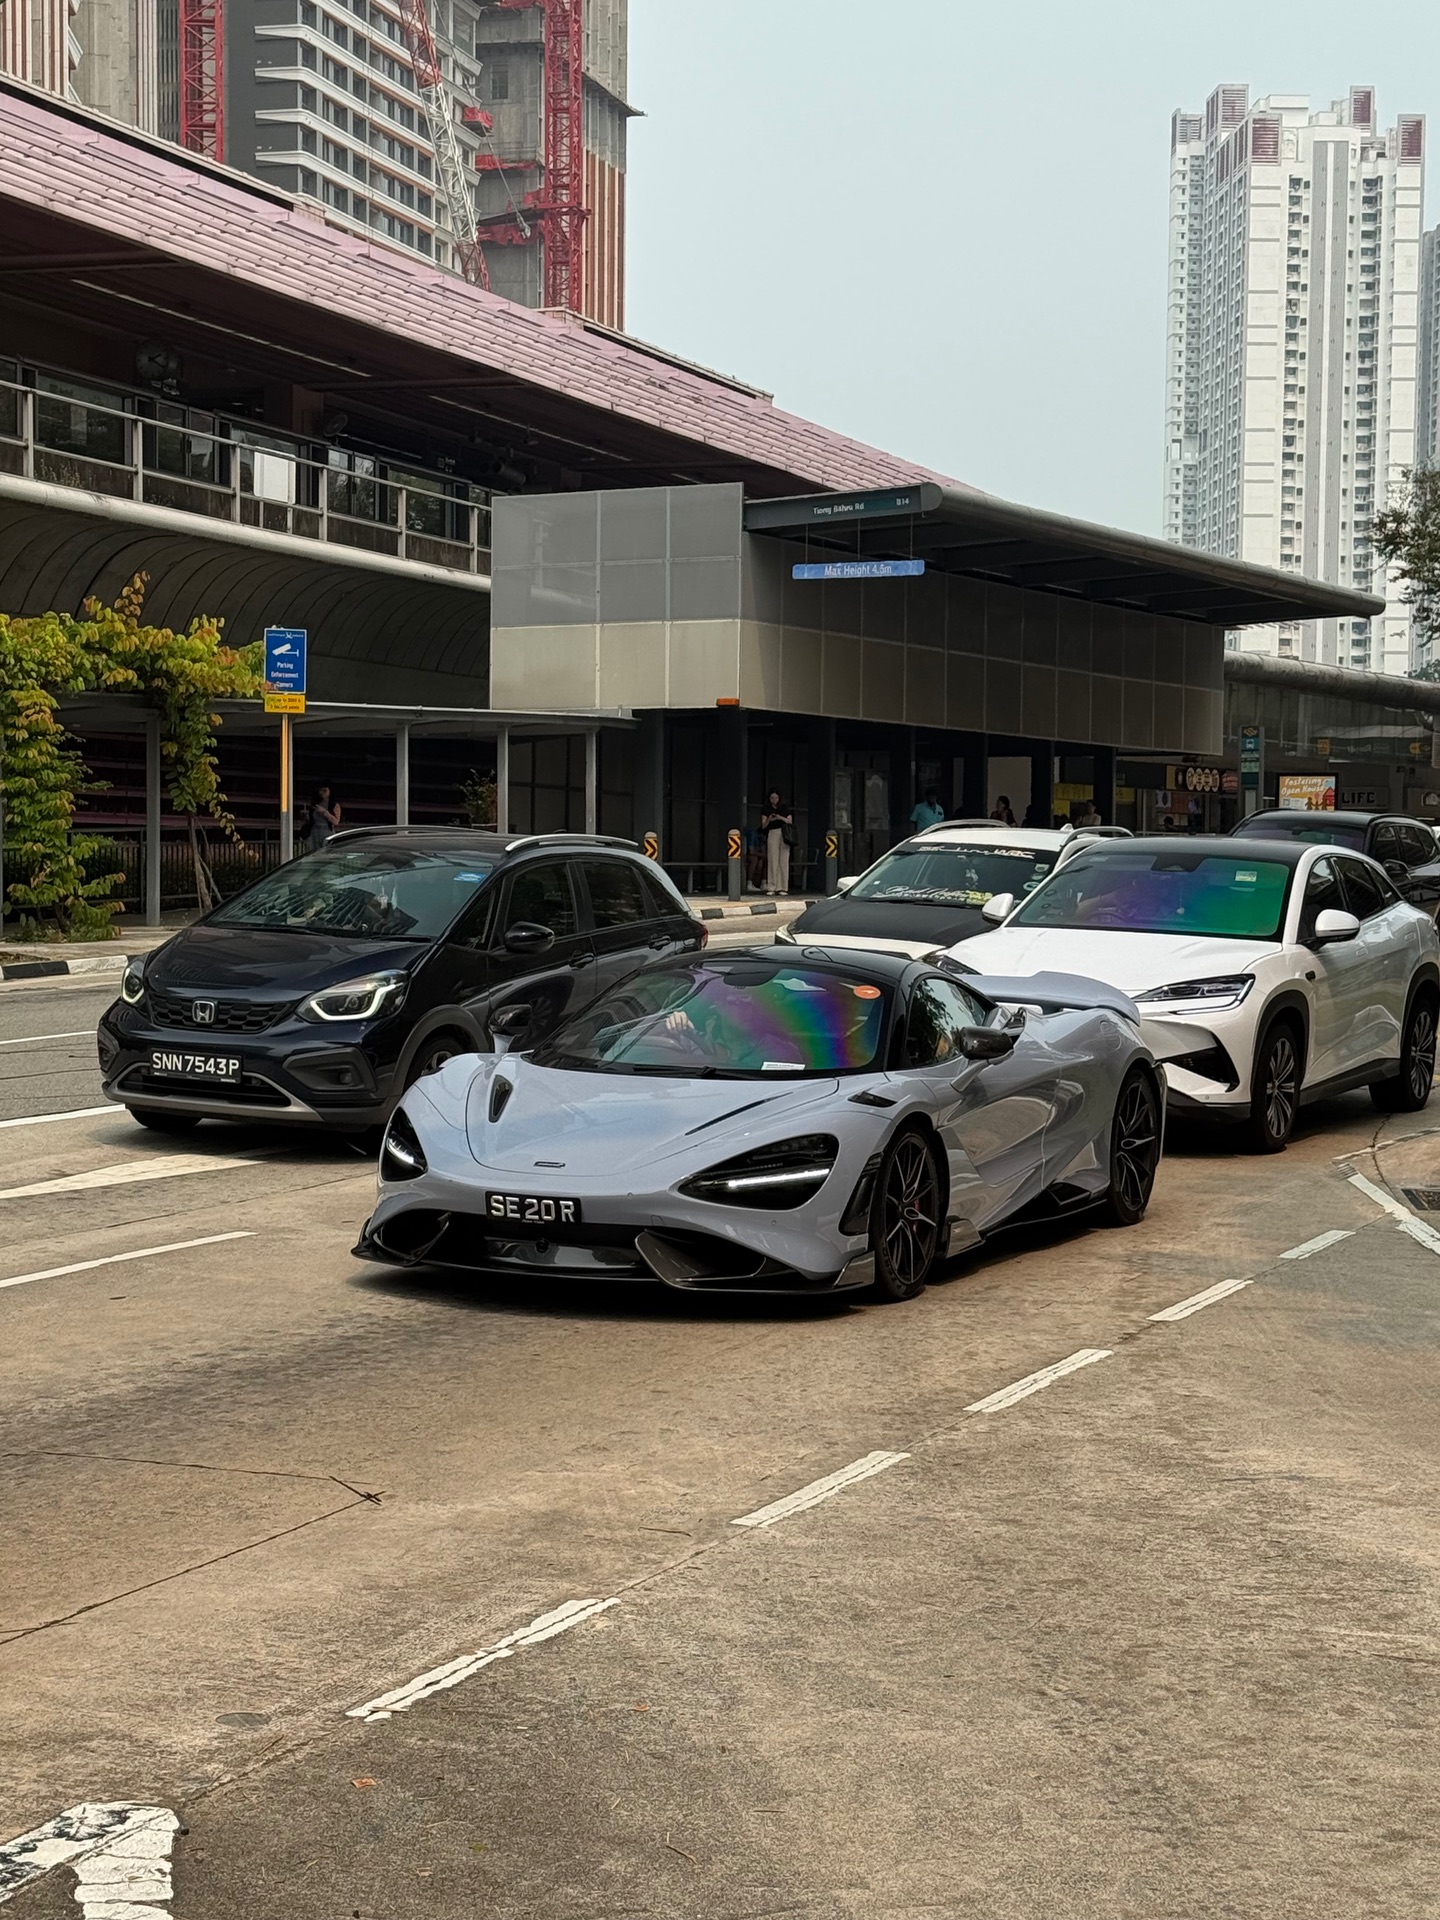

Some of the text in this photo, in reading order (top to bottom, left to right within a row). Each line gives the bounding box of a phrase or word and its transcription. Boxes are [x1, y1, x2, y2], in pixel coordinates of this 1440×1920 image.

[813, 506, 832, 515] Tiong
[833, 504, 853, 513] Bahru
[854, 503, 865, 511] Rd
[824, 564, 892, 576] Max Height 4.5m
[276, 662, 294, 670] Parking
[1284, 777, 1323, 786] Fostering
[1281, 785, 1324, 797] Open House
[152, 1052, 240, 1076] SNN7543P
